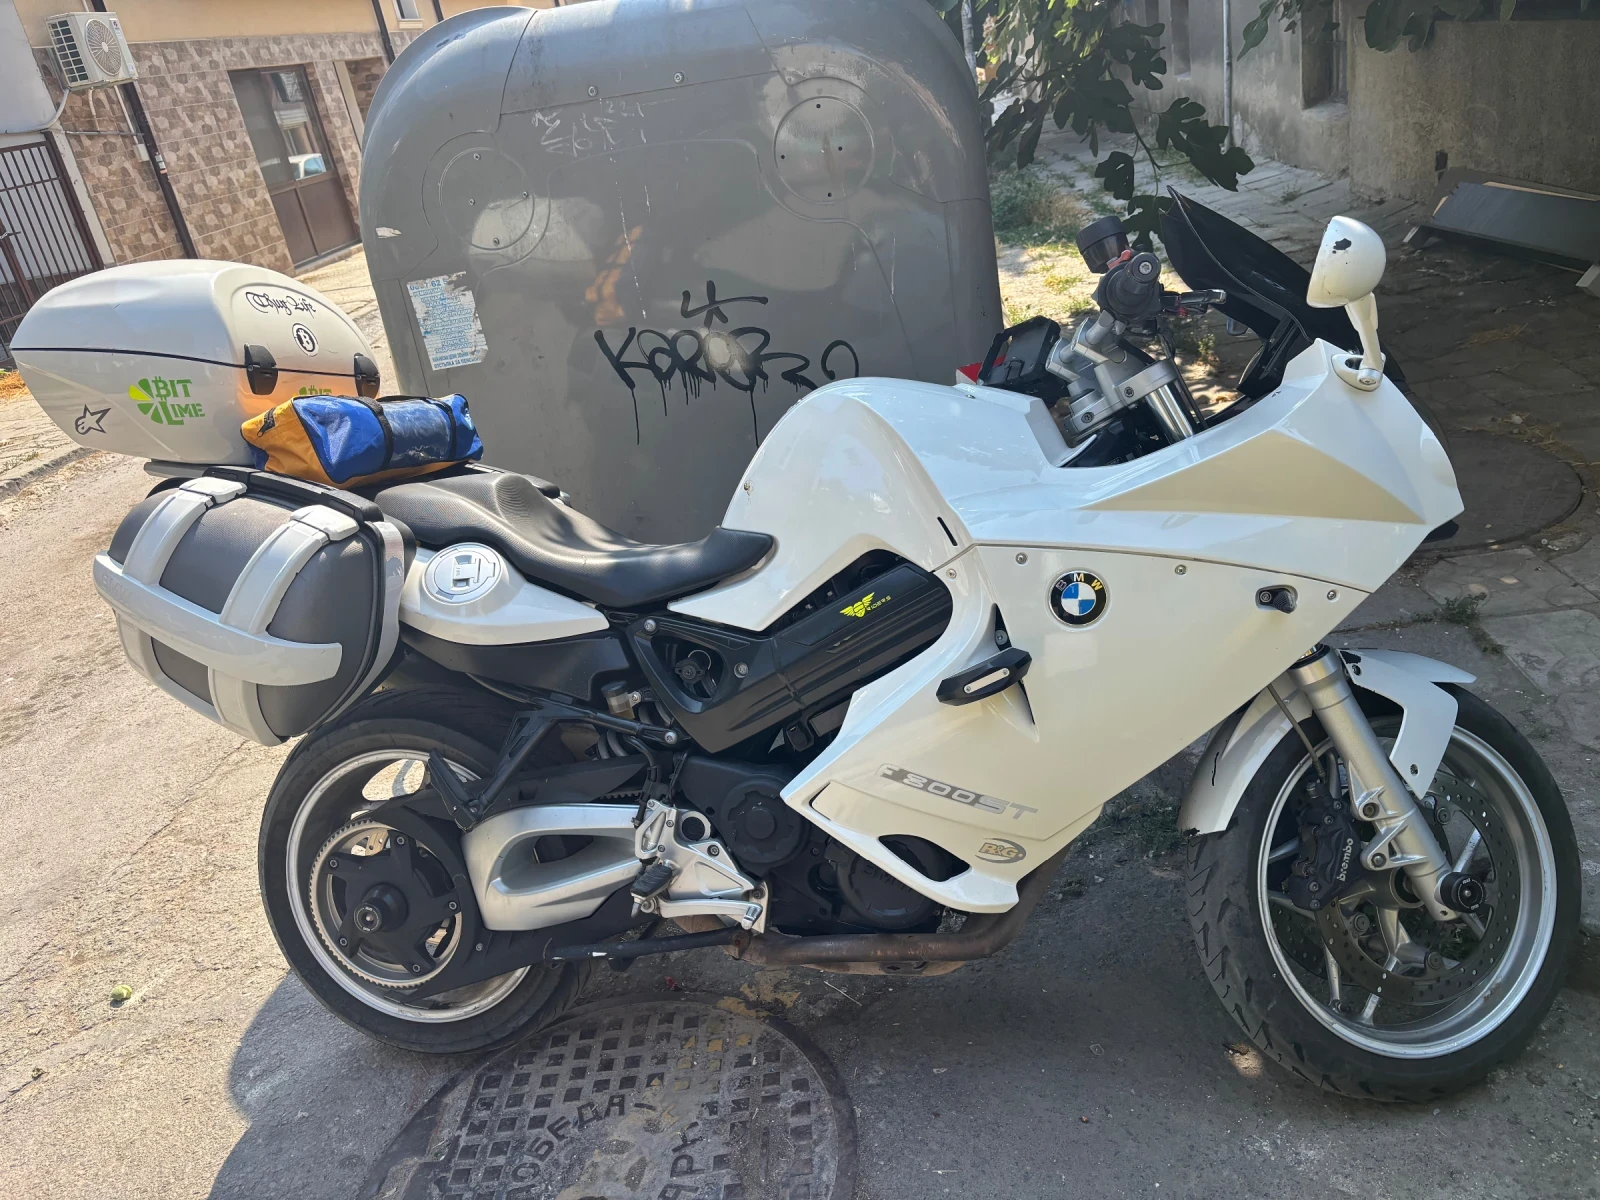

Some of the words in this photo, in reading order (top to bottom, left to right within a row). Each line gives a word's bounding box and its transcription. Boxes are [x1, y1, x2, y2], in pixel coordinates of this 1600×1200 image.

[430, 279, 442, 288] 62
[158, 401, 206, 426] LIME
[1055, 572, 1103, 592] BMW
[978, 841, 1019, 859] R&G
[1336, 837, 1354, 882] brembo
